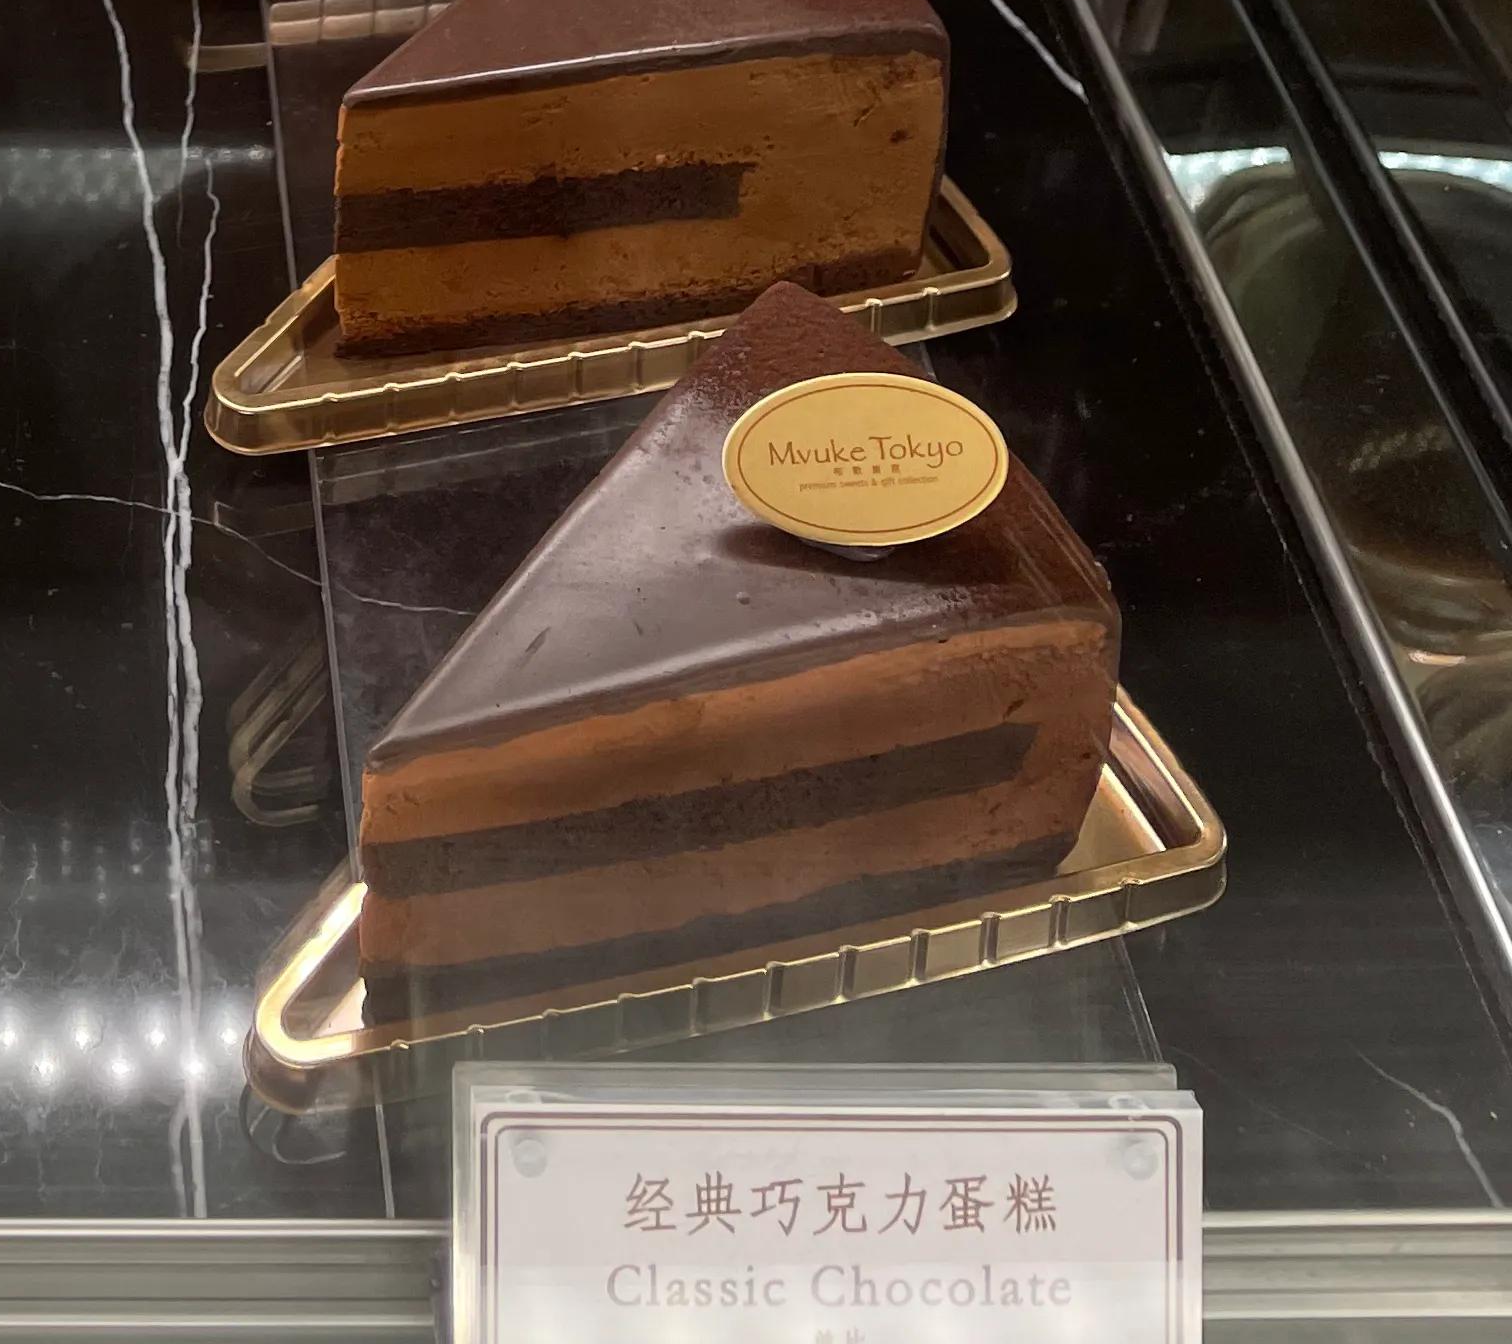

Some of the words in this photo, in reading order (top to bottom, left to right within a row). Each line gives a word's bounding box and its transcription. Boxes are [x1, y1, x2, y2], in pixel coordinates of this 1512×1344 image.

[768, 439, 866, 466] Mvuke
[868, 434, 964, 469] Tokyo
[624, 1171, 1057, 1236] 经典巧克力蛋糕
[607, 1265, 786, 1309] Classic
[810, 1264, 1072, 1309] Chocolate
